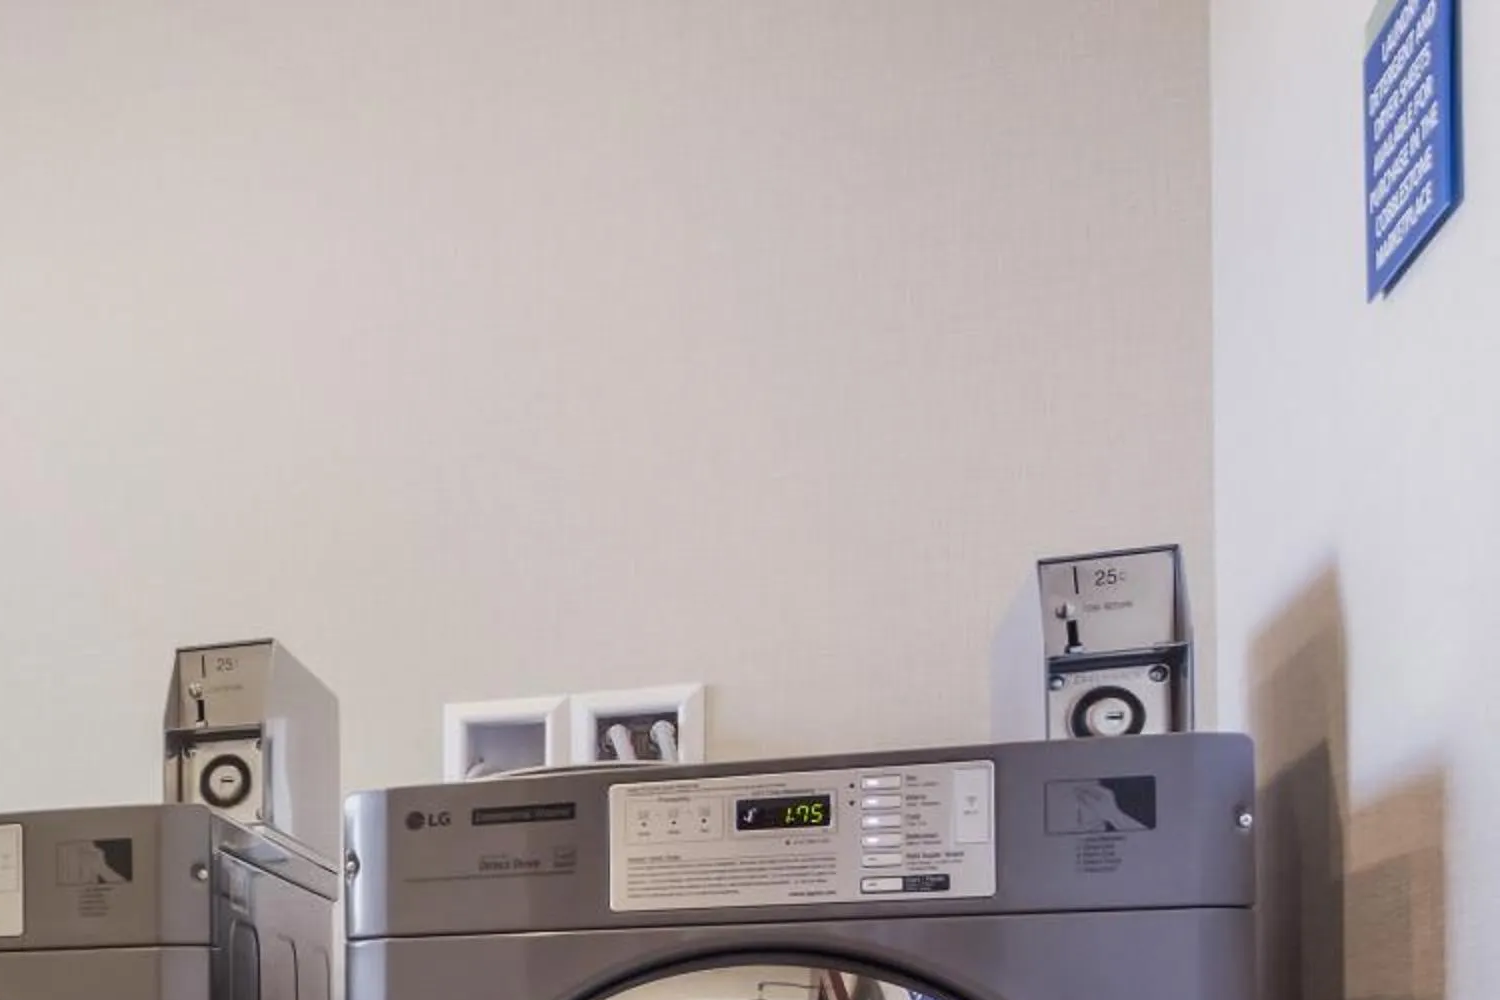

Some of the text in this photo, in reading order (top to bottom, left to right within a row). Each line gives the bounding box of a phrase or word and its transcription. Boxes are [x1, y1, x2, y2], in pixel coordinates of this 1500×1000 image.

[1369, 0, 1436, 117] DETERGENT AND
[1373, 41, 1431, 141] DRYER SHEETS
[1369, 100, 1439, 214] PURCHASE IN THE
[1373, 74, 1434, 178] AVAILABLE FOR
[1375, 180, 1432, 270] MARKETPLACE
